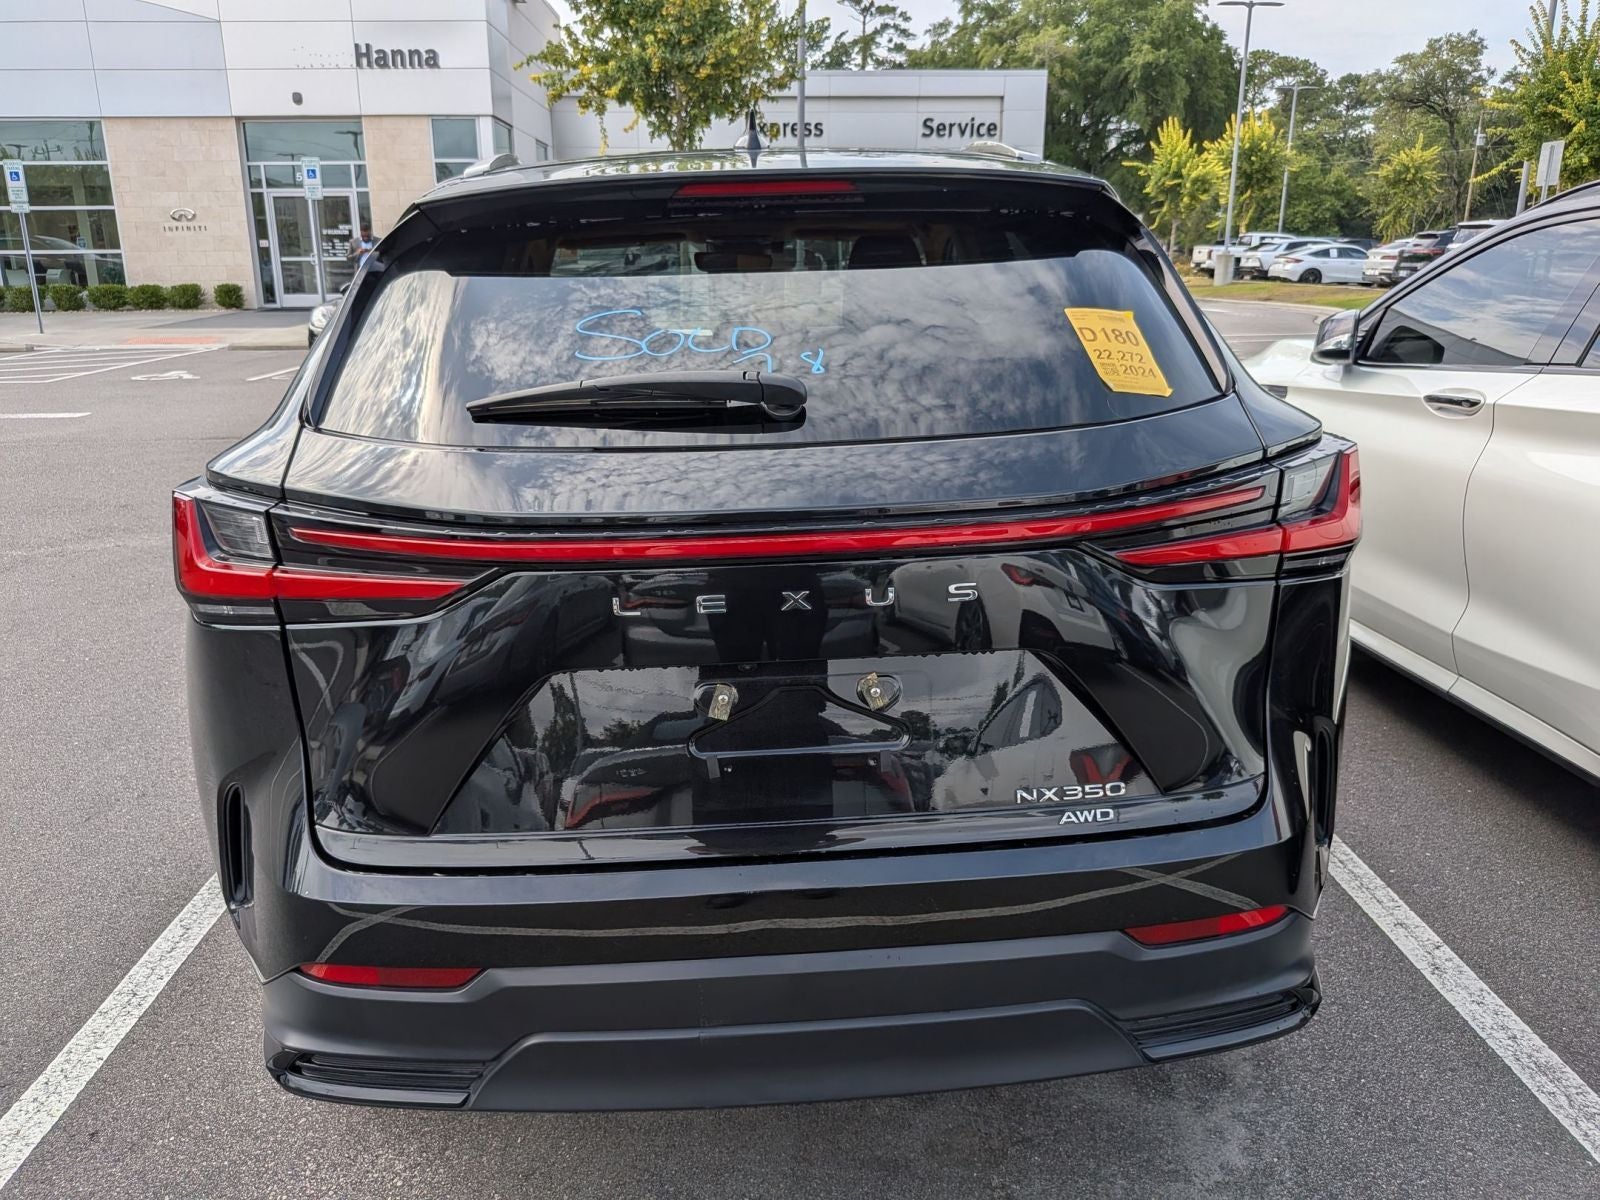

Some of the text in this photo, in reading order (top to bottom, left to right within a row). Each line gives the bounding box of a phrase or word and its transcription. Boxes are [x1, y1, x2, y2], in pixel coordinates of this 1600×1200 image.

[354, 42, 441, 70] Hanna
[755, 117, 999, 144] xpress Service
[1119, 363, 1157, 379] 2024
[612, 582, 978, 616] LEXUS
[1059, 808, 1115, 825] AWD
